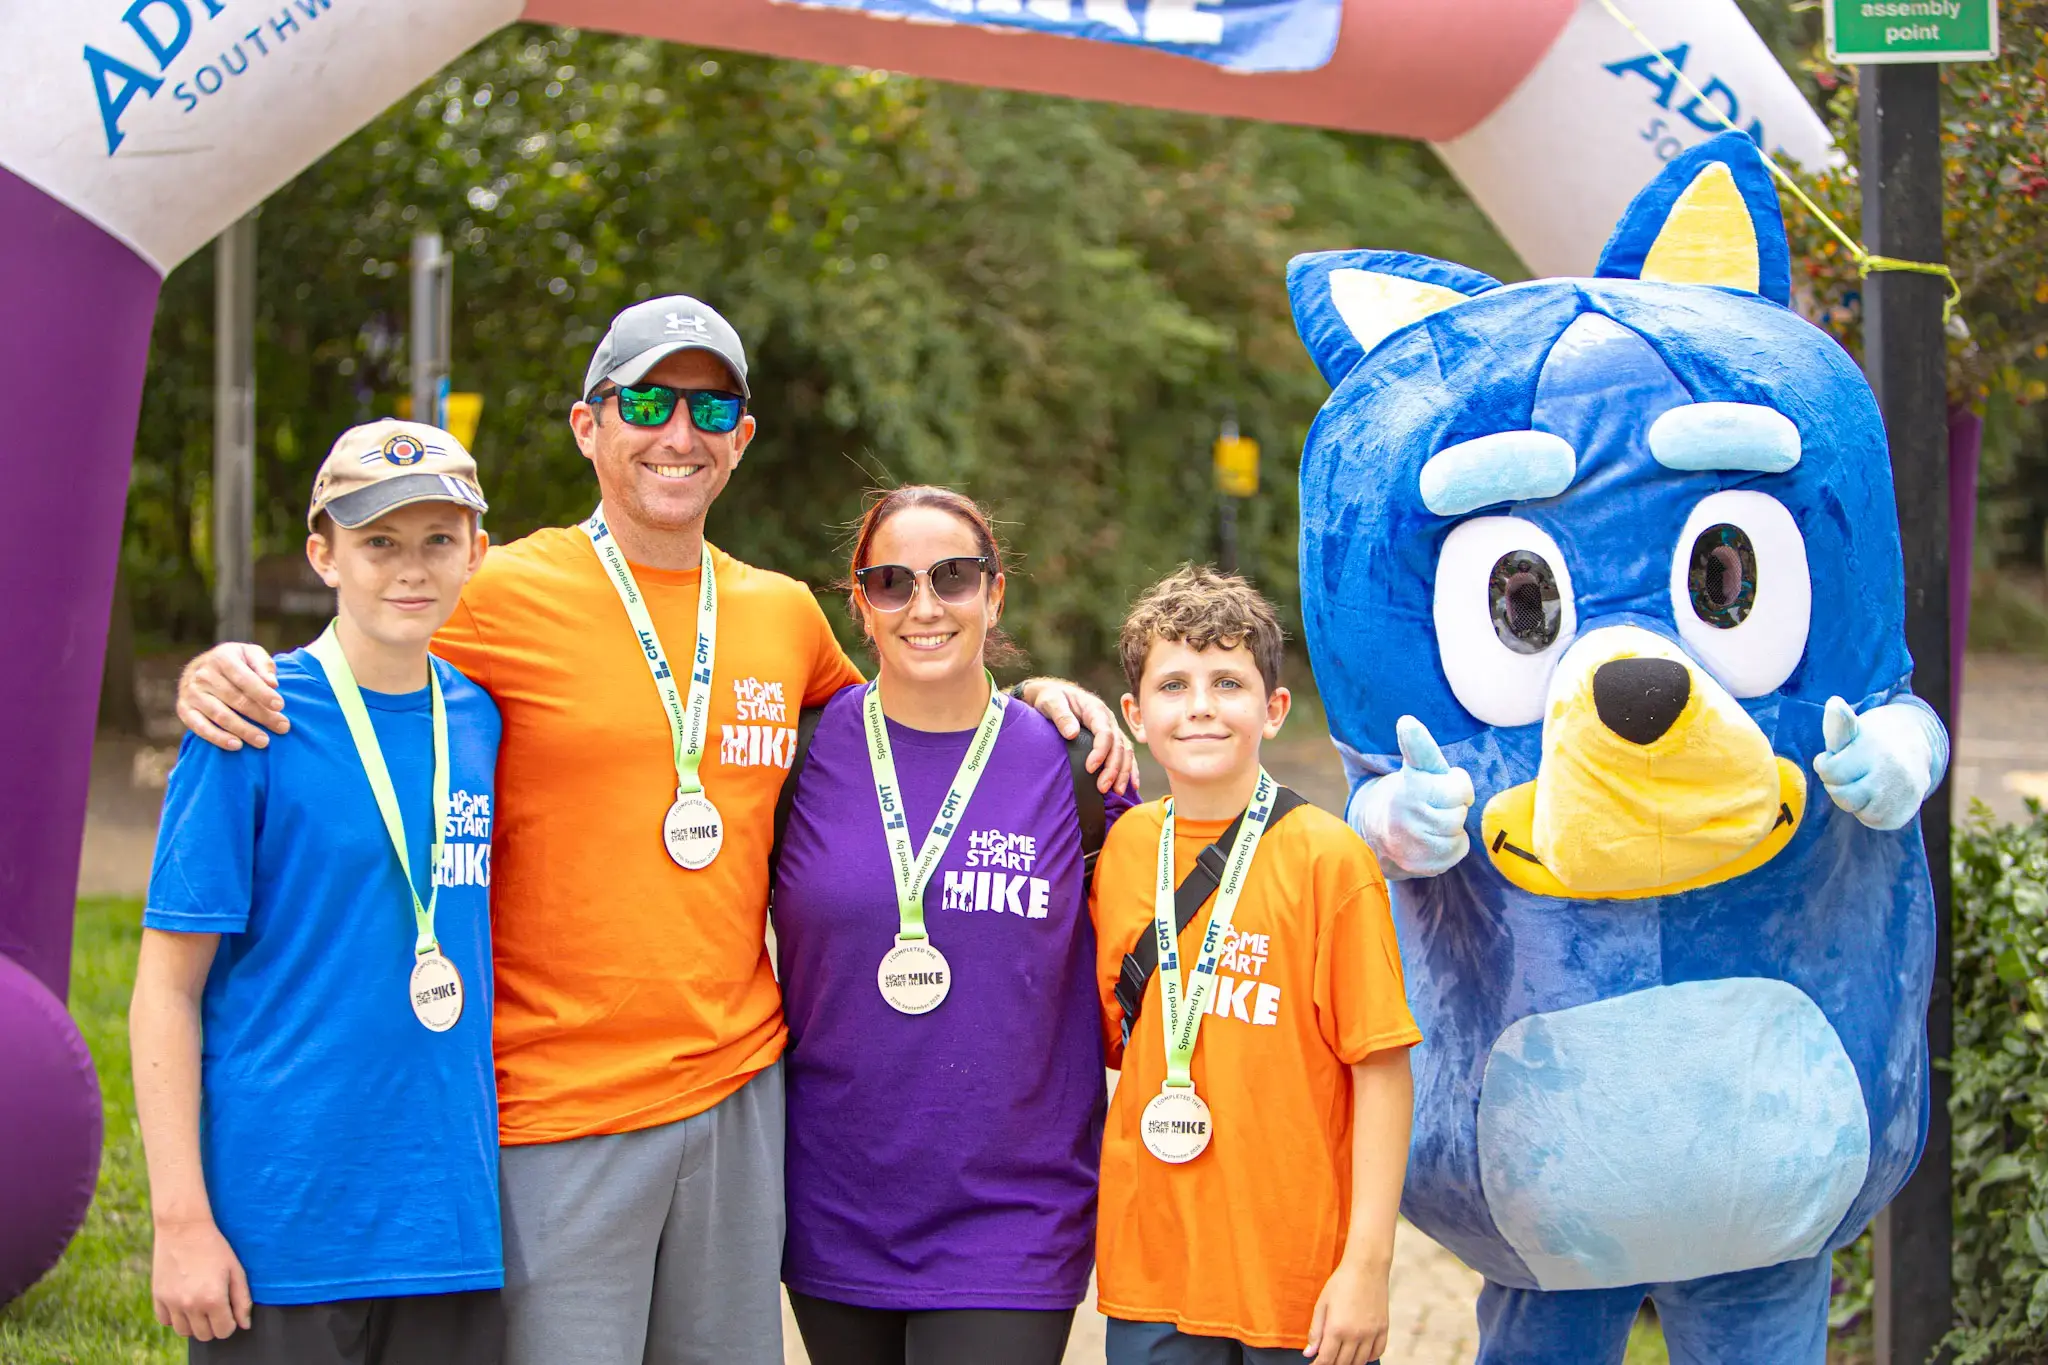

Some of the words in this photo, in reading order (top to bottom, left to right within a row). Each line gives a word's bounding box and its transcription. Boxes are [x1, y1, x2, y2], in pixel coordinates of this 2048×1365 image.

[1861, 0, 1961, 20] assembly
[1884, 23, 1941, 44] point
[83, 0, 226, 158] AD
[604, 546, 615, 558] by
[609, 556, 638, 604] Sponsored
[638, 630, 659, 660] CMT
[697, 633, 710, 664] CMT
[666, 689, 675, 702] by
[694, 693, 705, 706] by
[733, 676, 785, 702] HOME
[736, 700, 787, 722] START
[868, 702, 877, 714] by
[688, 706, 702, 754] Sponsored
[870, 714, 886, 760] Sponsored
[968, 726, 993, 772] Sponsored
[988, 716, 998, 727] by
[878, 784, 895, 812] CMT
[1255, 774, 1272, 802] CMT
[942, 789, 962, 819] CMT
[445, 815, 491, 838] START
[896, 839, 906, 851] by
[968, 829, 1036, 854] HOME
[908, 854, 933, 902] Sponsored
[927, 844, 940, 856] by
[964, 849, 1036, 872] START
[1225, 844, 1250, 894] Sponsored
[1244, 831, 1256, 842] by
[942, 870, 1050, 920] HIKE
[1158, 918, 1170, 950] CMT
[1204, 920, 1221, 954] CMT
[892, 946, 925, 960] COMPLETED
[926, 950, 936, 960] THE
[1220, 949, 1268, 976] ART
[885, 973, 906, 982] HOME
[908, 972, 944, 986] HIKE
[1168, 982, 1177, 994] by
[1178, 998, 1201, 1050] Sponsored
[1193, 984, 1205, 998] by
[1172, 1121, 1206, 1135] HIKE
